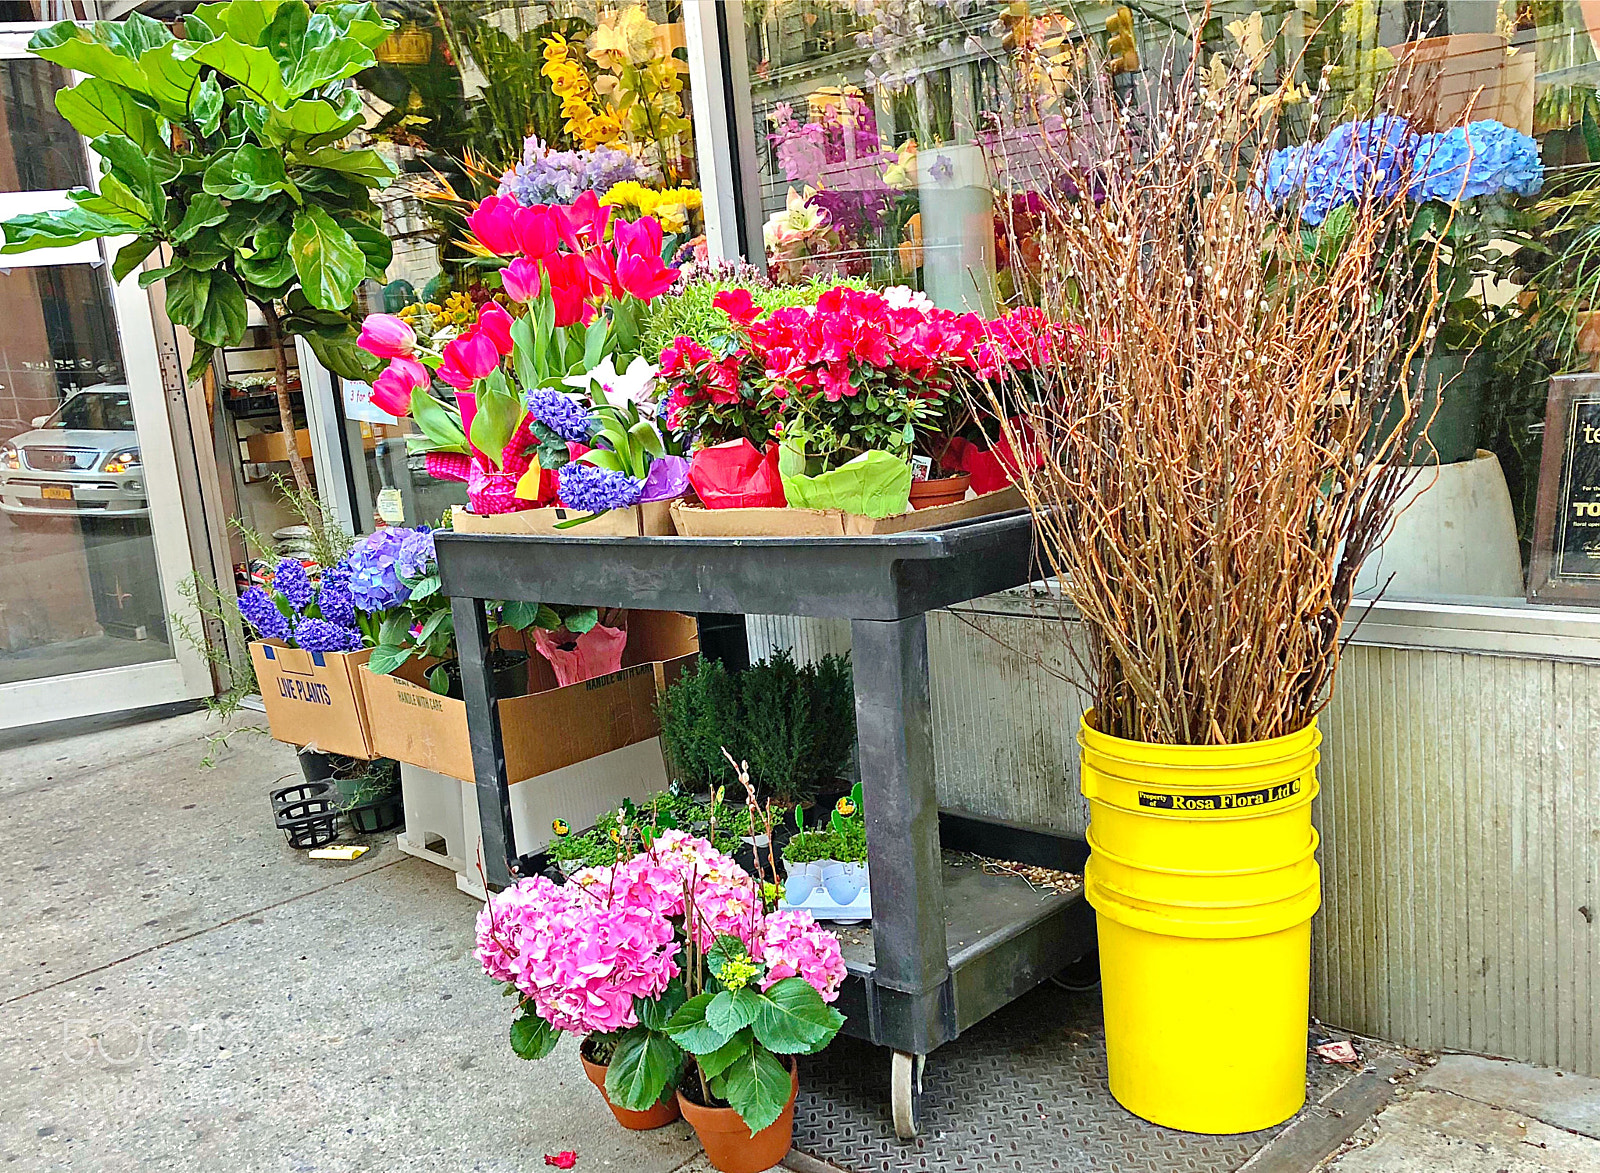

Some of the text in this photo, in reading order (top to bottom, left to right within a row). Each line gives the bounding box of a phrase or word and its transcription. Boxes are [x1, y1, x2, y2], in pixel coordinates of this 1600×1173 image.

[350, 390, 355, 401] 3
[276, 676, 331, 705] LIVE PLANTS
[397, 690, 444, 712] HANDLE WITH CARE
[1140, 791, 1167, 802] Property
[1171, 795, 1215, 810] Rosa
[1219, 794, 1264, 809] Flora
[1268, 783, 1290, 802] Ltd
